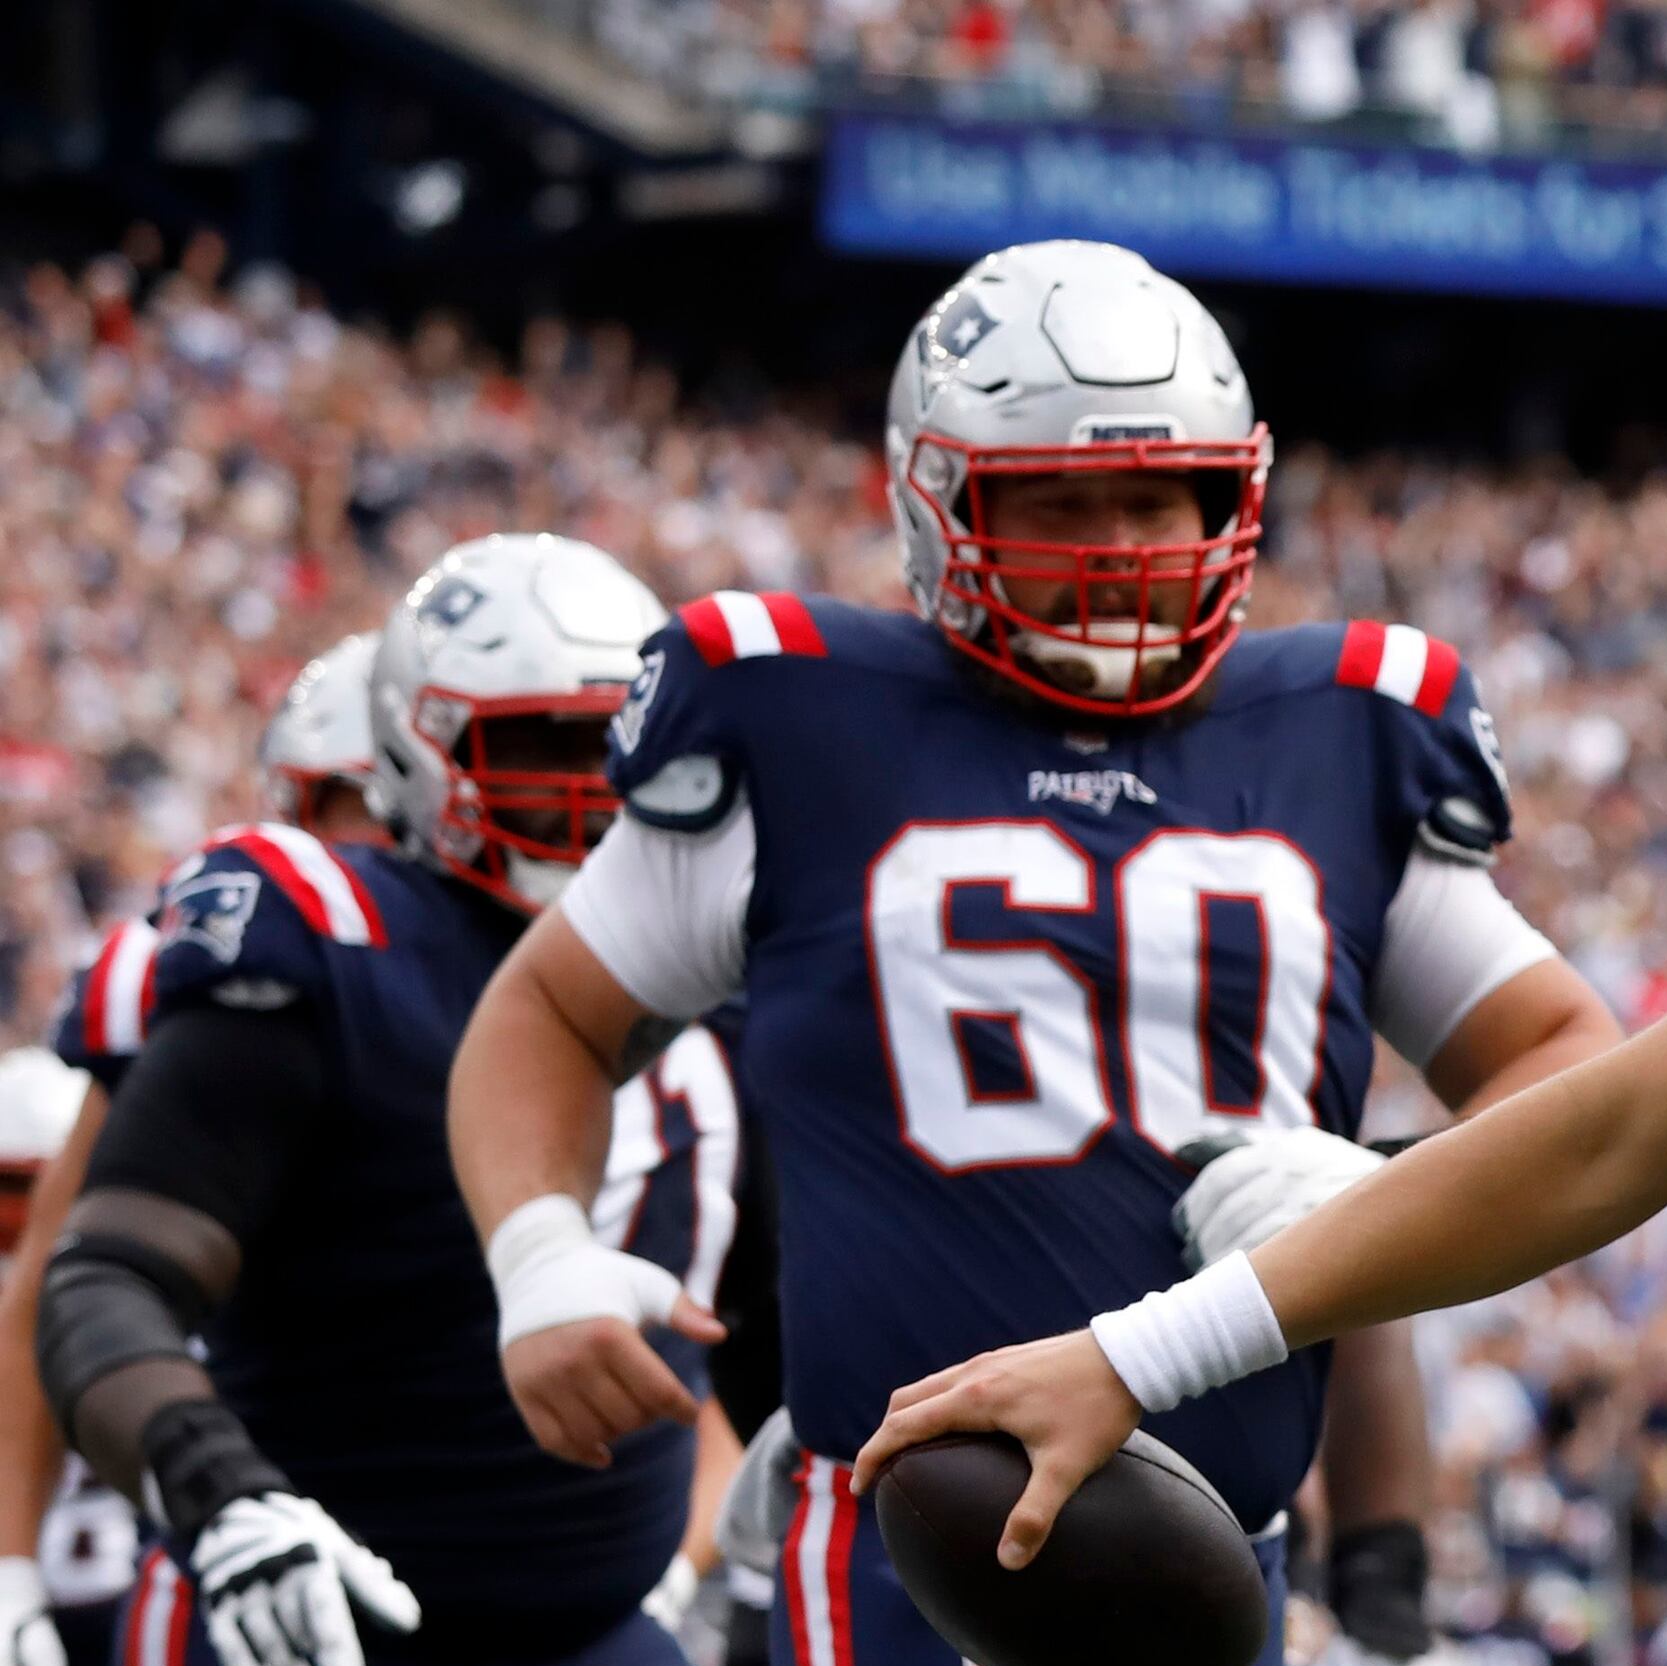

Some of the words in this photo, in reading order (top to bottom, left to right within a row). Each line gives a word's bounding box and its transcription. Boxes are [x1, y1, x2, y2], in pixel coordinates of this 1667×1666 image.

[1027, 137, 1279, 234] Mobile
[1288, 148, 1528, 256] Tickets
[1540, 163, 1636, 264] for
[1028, 769, 1158, 804] PATRIOTS
[864, 816, 1333, 1178] 60
